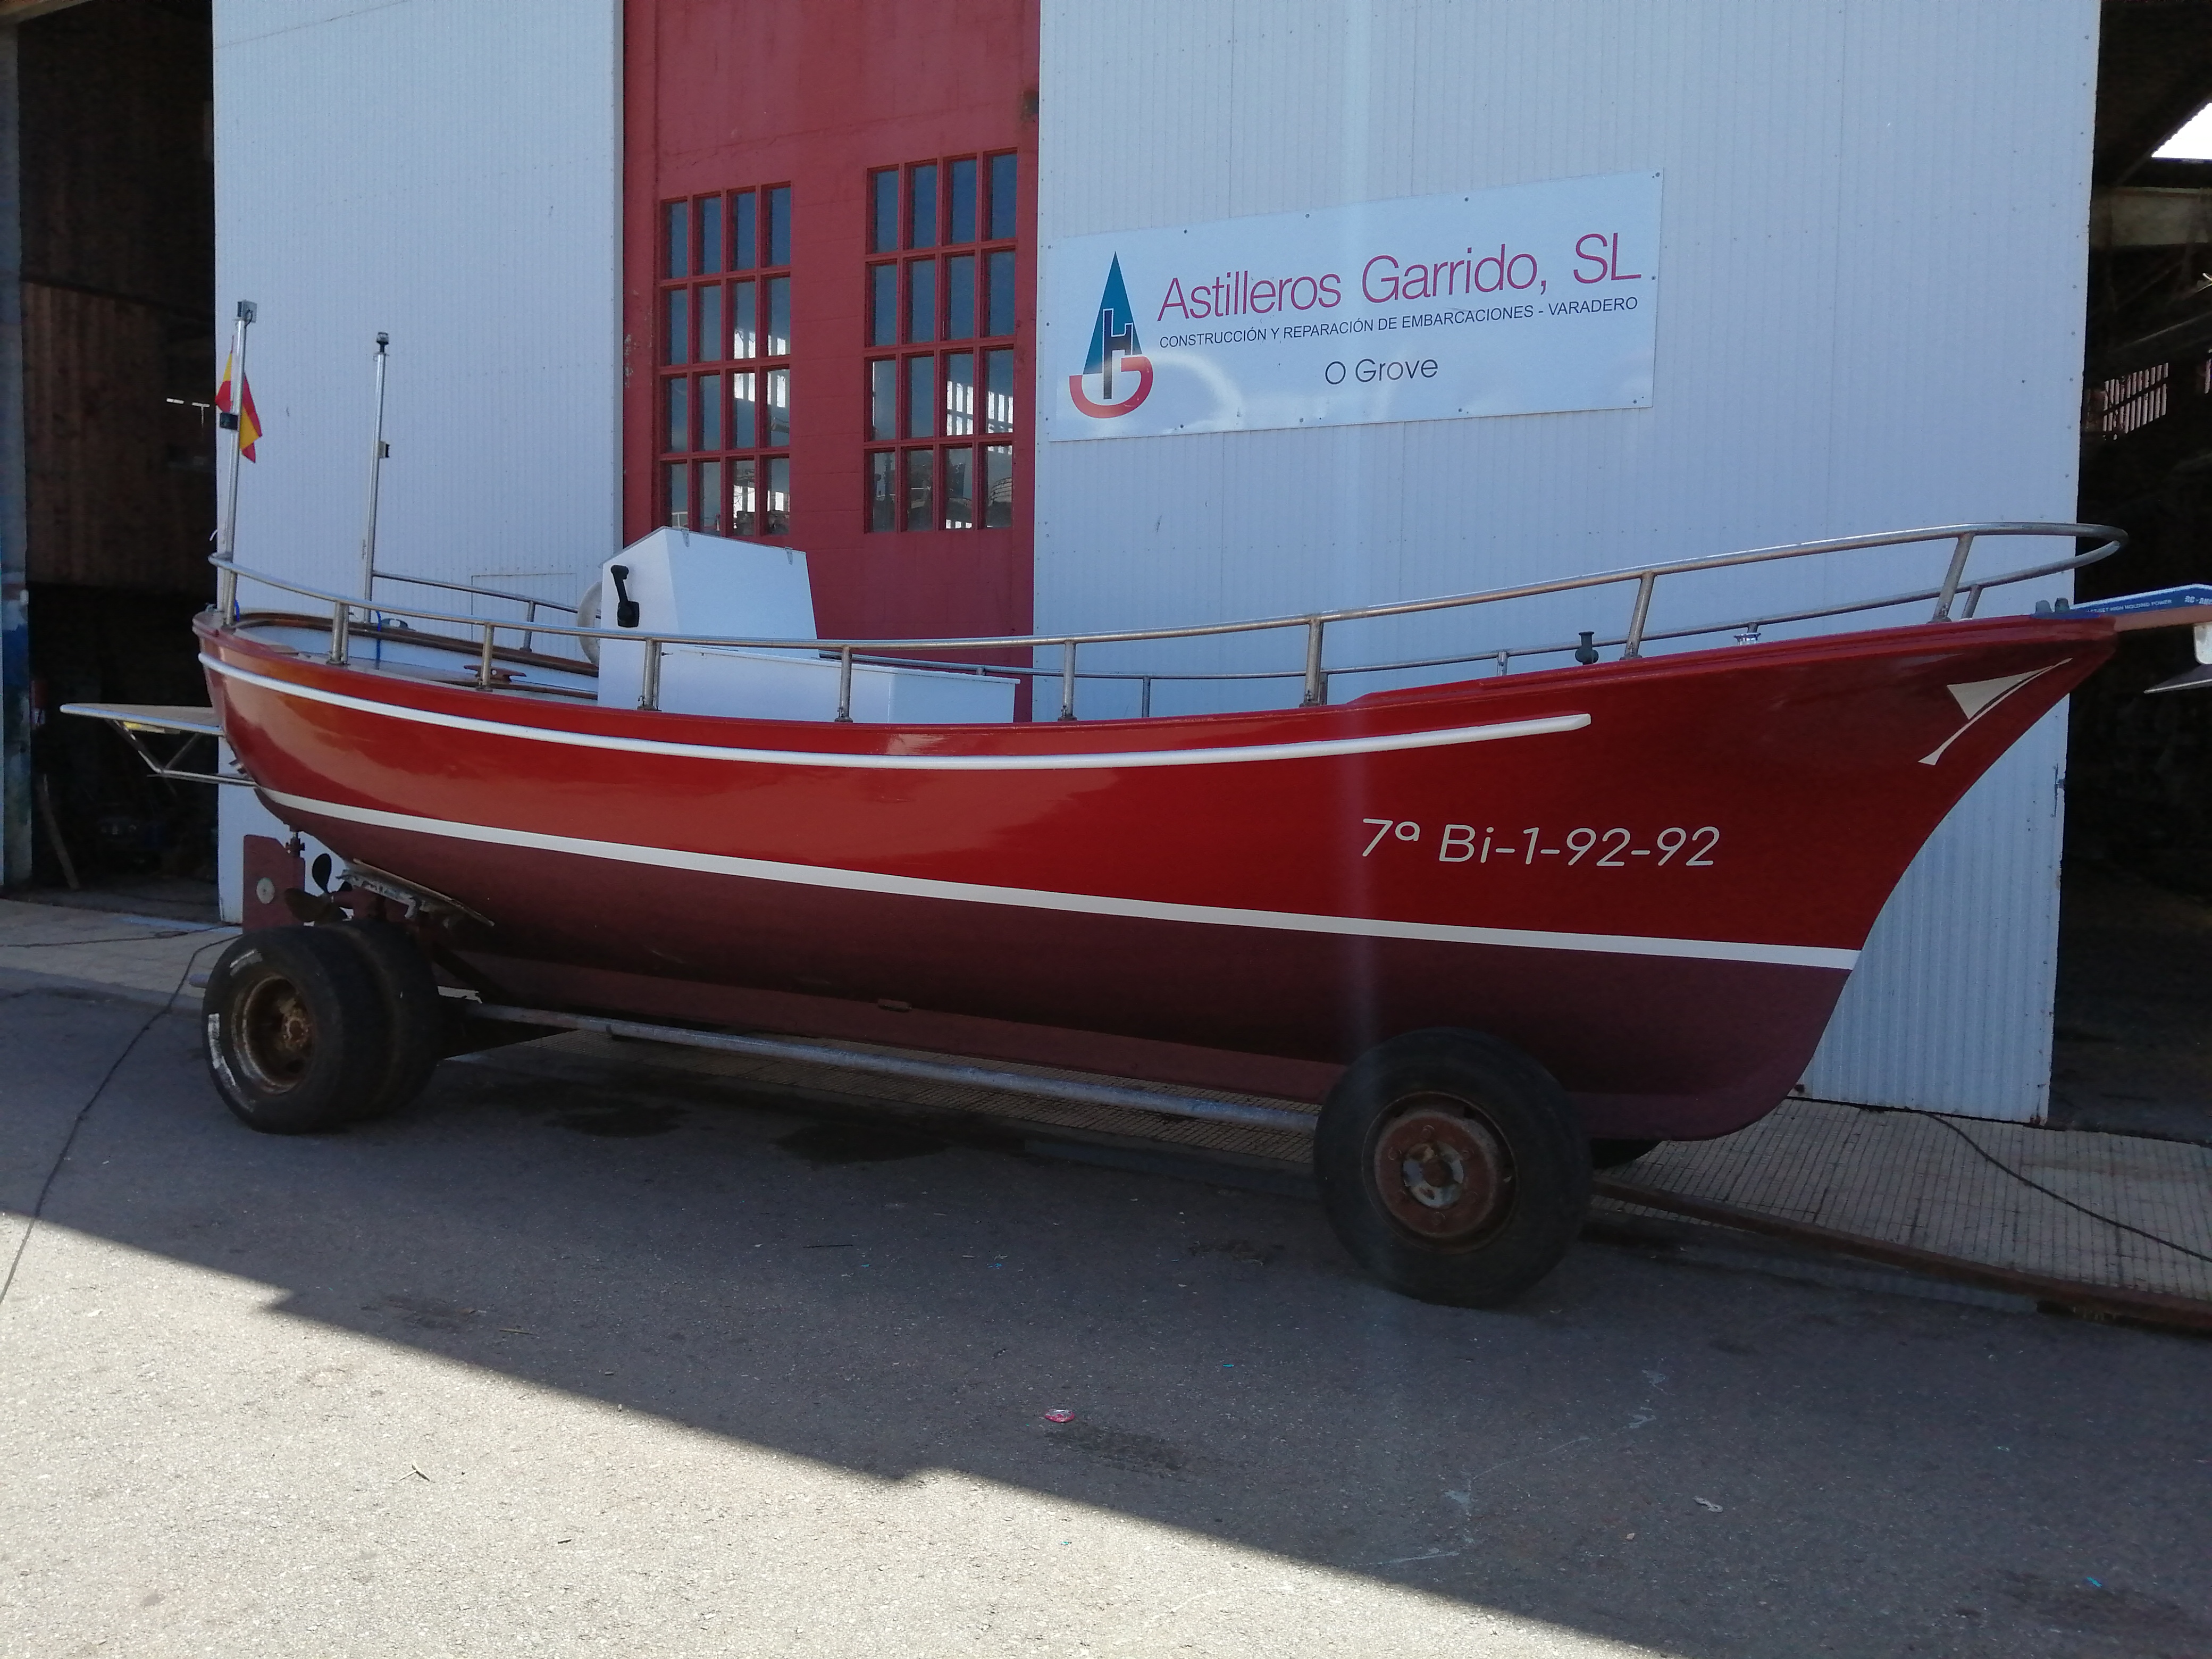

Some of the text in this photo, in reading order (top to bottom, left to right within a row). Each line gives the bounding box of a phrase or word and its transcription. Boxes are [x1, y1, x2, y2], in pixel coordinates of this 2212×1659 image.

[1157, 232, 1641, 322] Astilleros Garrido, SL
[1159, 326, 1267, 349] CONSTRUCCIÓN
[1270, 328, 1280, 339] Y
[1283, 317, 1373, 339] REPARACIÓN
[1378, 317, 1397, 331] DE
[1402, 305, 1534, 329] EMBARCACIONES
[1548, 296, 1638, 316] VARADERO
[1325, 357, 1439, 386] O Grove
[1438, 823, 1720, 867] Bi-1-92-92
